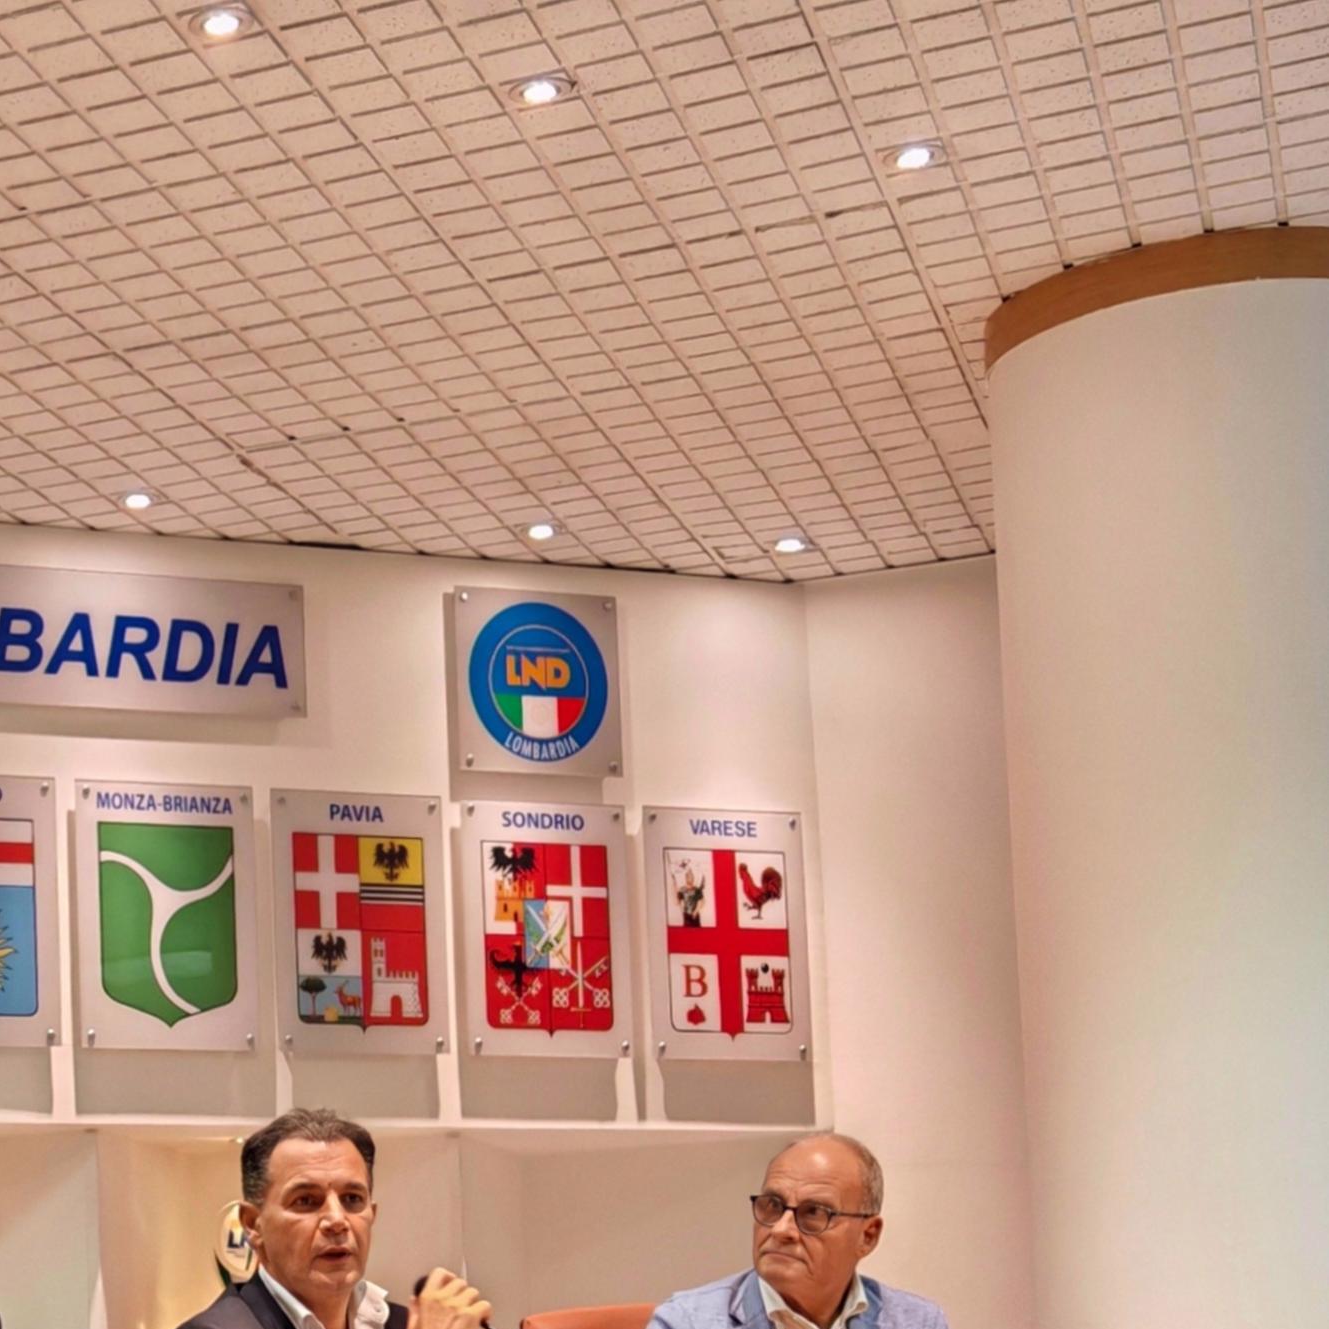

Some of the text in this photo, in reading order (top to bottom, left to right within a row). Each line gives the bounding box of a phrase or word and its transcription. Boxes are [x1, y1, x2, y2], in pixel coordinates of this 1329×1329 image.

[506, 653, 571, 690] LND
[504, 730, 580, 761] LOMBARDIA
[96, 790, 234, 816] MONZA-BRIANZA
[329, 803, 384, 823] PAVIA
[502, 810, 585, 832] SONDRIO
[689, 818, 758, 838] VARESE
[681, 964, 709, 998] B
